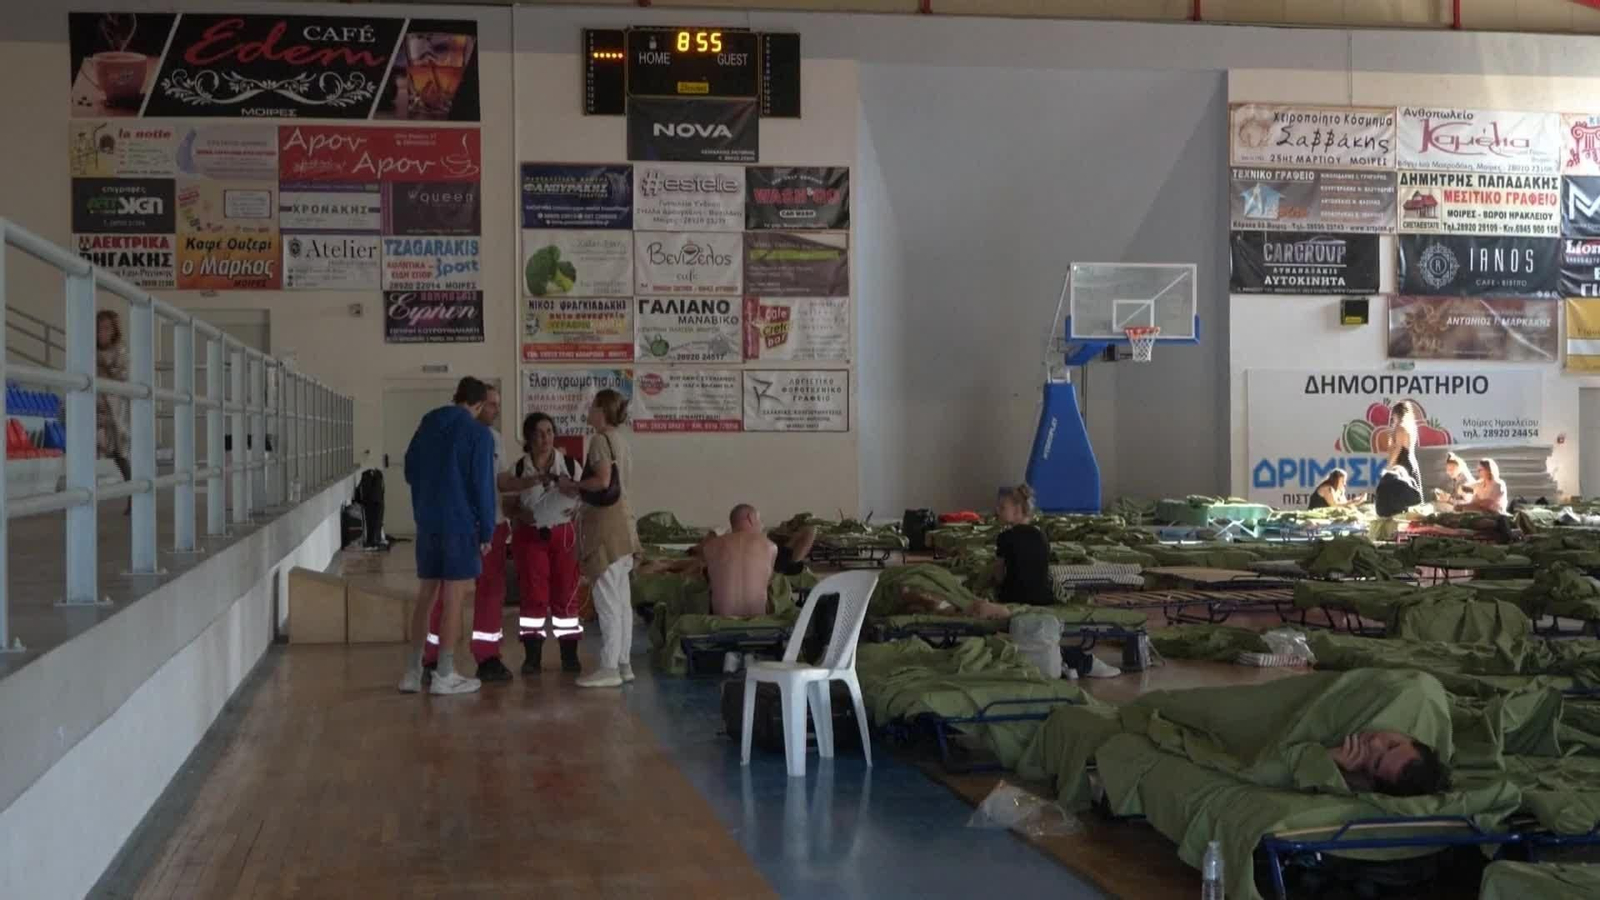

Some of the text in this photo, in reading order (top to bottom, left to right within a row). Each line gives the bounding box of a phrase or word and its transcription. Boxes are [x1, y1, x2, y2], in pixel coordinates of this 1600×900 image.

[303, 24, 376, 43] CAFÉ
[677, 31, 722, 52] 8 55
[184, 17, 386, 67] Edem
[638, 52, 672, 65] HOME
[717, 53, 749, 66] GUEST
[1344, 113, 1391, 129] Κόσμημα
[1403, 108, 1473, 121] Ανθοπωλείο
[653, 122, 732, 138] NOVA
[1295, 156, 1341, 166] ΜΑΡΤΙΟΥ
[1350, 157, 1387, 167] ΜΟΙΡΕΣ
[1233, 169, 1315, 182] ΤΕΧΝΙΚΟ ΓΡΑΦΕΙΟ
[1400, 173, 1559, 190] ΔΗΜΗΤΡΗΣ ΠΑΠΑΔΑΚΗΣ
[1444, 190, 1558, 206] ΜΕΣΙΤΙΚΟ ΓΡΑΦΕΙΟ
[293, 204, 368, 214] ΧΡΟΝΑΚΗΣ
[1447, 210, 1553, 221] ΜΟΙΡΕΣ ΒΩΡΟΙ ΗΡΑΚΛΕΙΟΥ
[306, 239, 377, 259] Atelier
[384, 239, 479, 256] TZAGARAKIS
[1263, 242, 1347, 264] CARGROUP
[1469, 247, 1535, 273] IANOS
[1264, 275, 1346, 286] ΑΥΤΟΚΙΝΗΤΑ
[639, 300, 730, 314] ΓΑΛΙΑΝΟ
[678, 316, 740, 325] ΜΑΝΑΒΙΚΟ
[788, 378, 835, 386] ΛΟΓΙΣΤΙΚΟ
[1305, 375, 1489, 394] ΔΗΜΟΠΡΑΤΗΡΙΟ
[1463, 429, 1540, 440] τηλ. 28920 24454
[1253, 457, 1387, 488] ΔΡΙΜΙΣΚ
